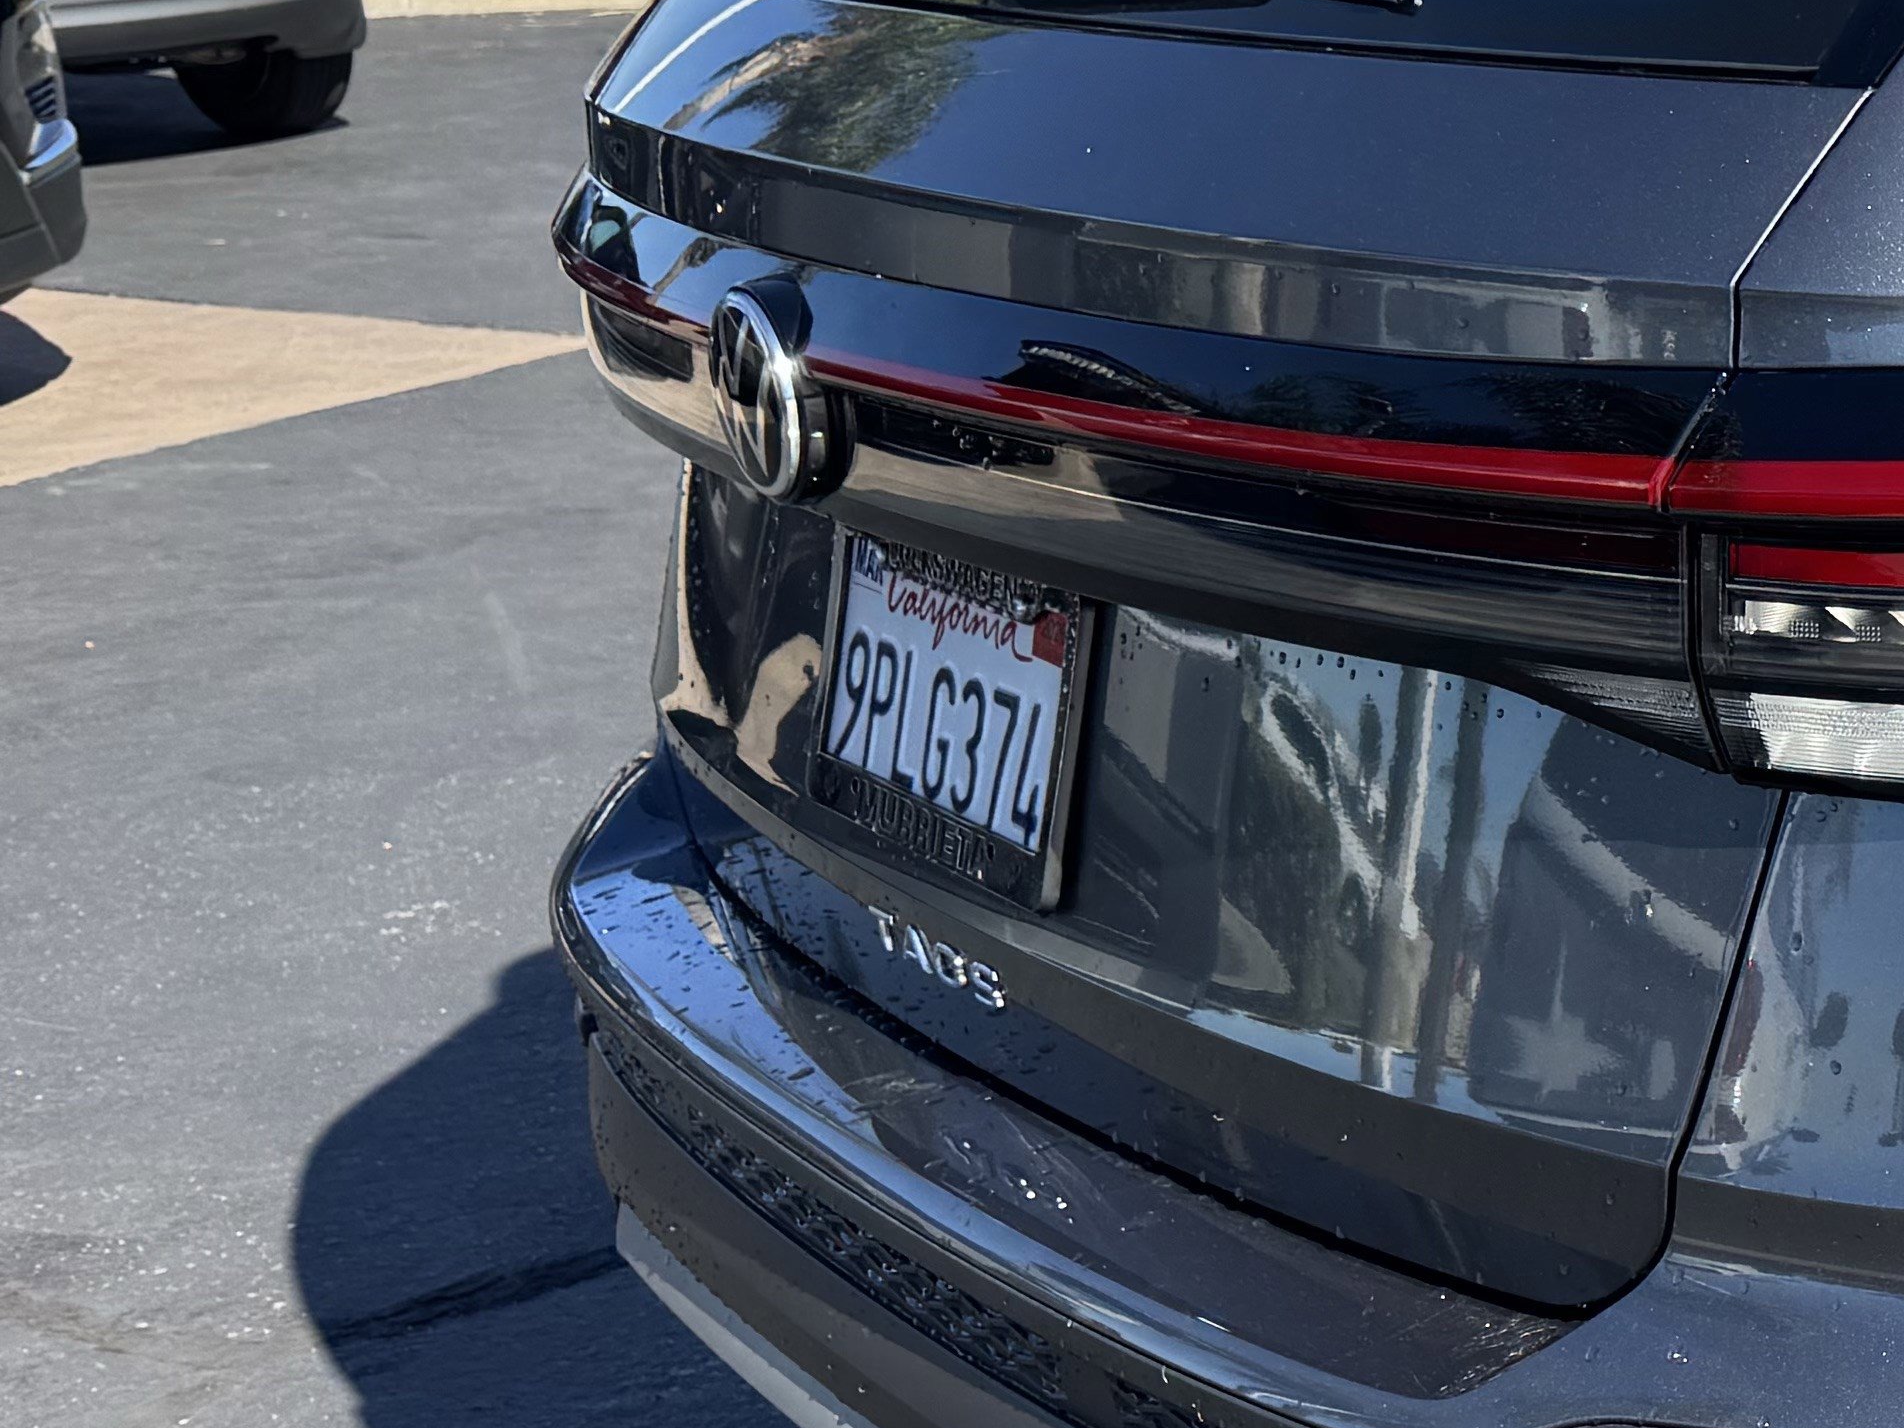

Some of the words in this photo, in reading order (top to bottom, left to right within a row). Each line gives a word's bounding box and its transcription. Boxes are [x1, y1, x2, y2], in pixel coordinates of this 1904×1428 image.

[888, 572, 1033, 662] California
[832, 628, 1042, 847] 9PLG374
[868, 905, 1006, 1008] TAOS
